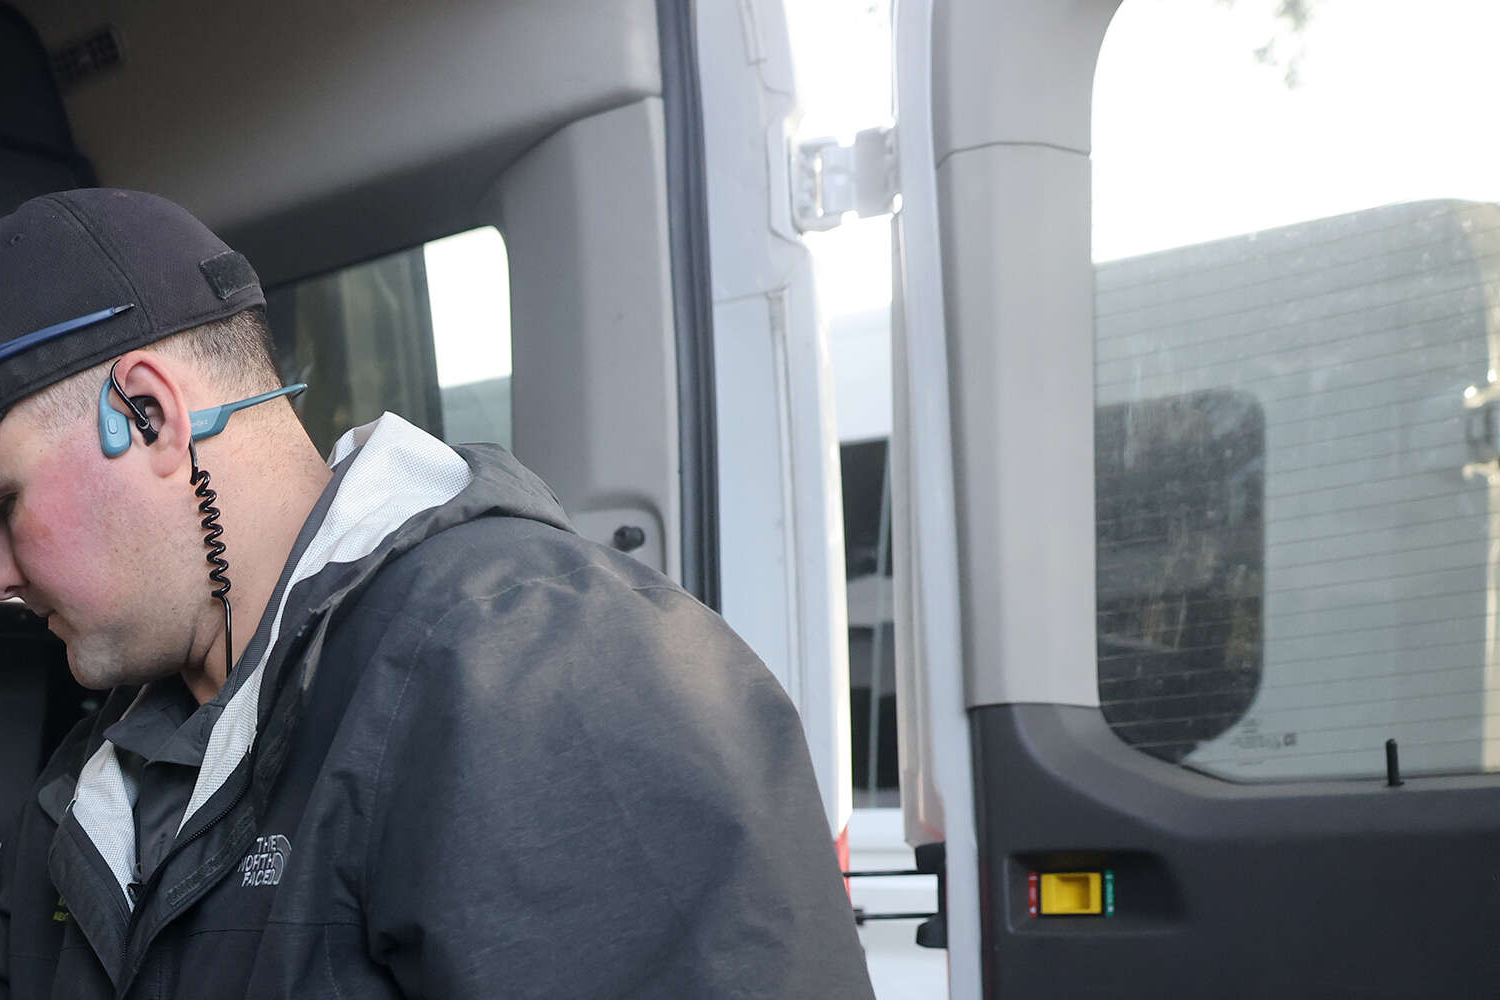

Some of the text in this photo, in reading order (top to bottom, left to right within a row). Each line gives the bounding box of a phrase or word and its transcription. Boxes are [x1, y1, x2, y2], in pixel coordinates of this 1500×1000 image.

[256, 835, 277, 852] THE
[237, 853, 275, 873] NORTH
[241, 869, 271, 887] FACE
